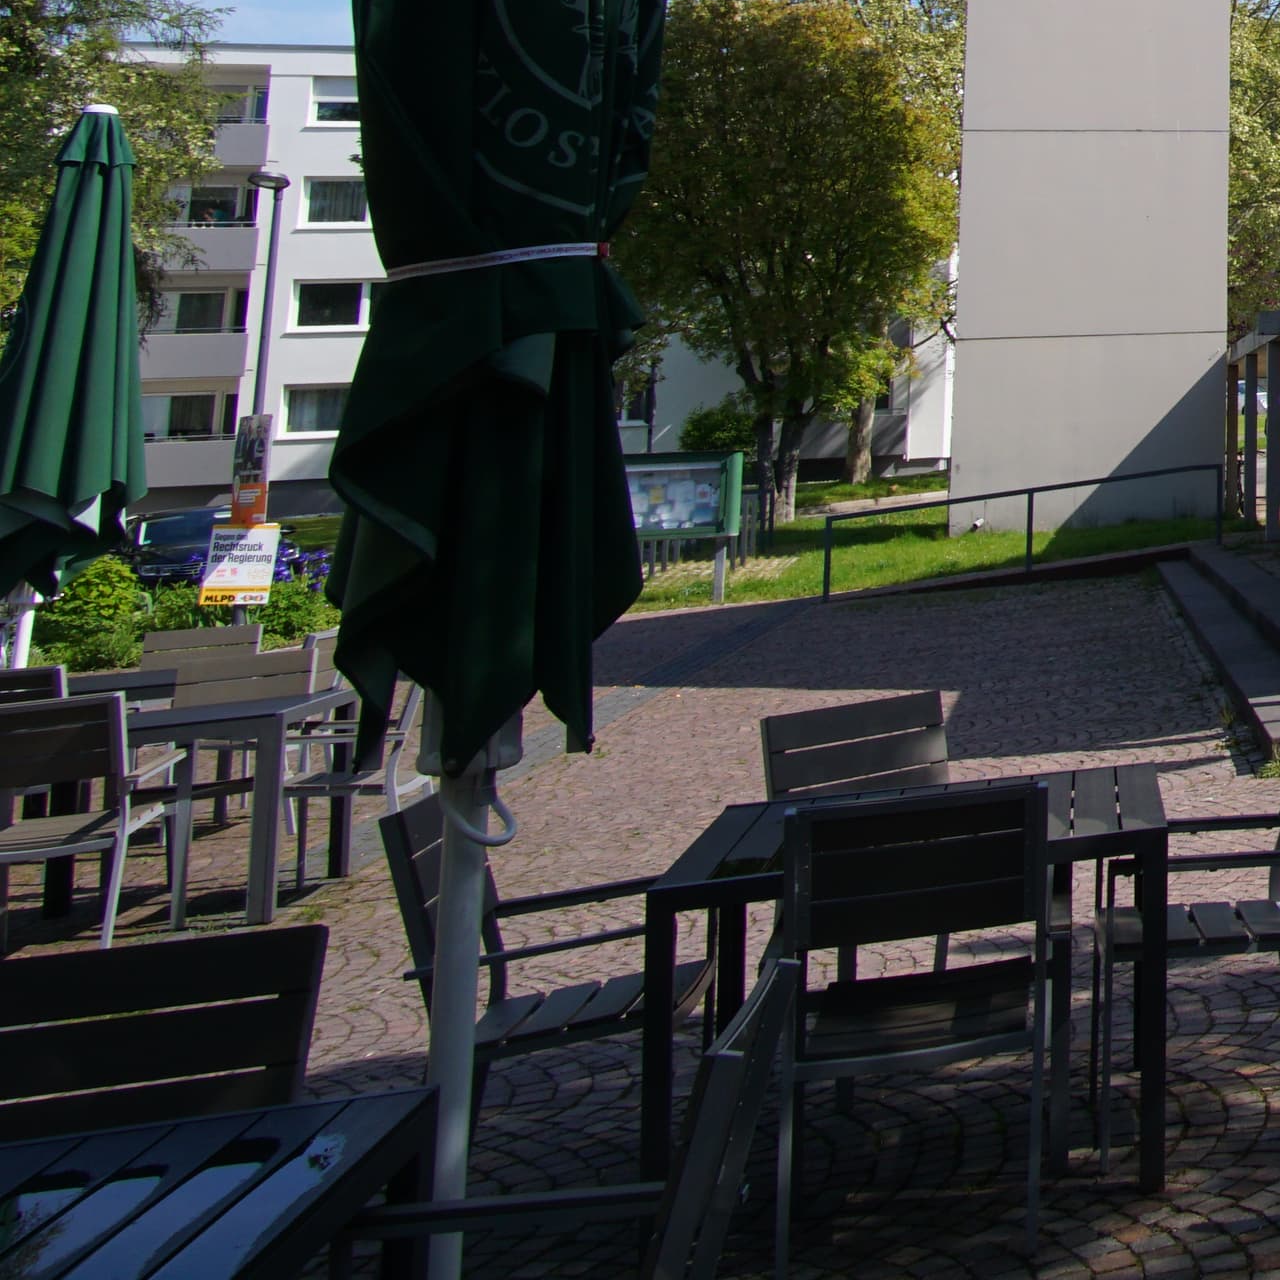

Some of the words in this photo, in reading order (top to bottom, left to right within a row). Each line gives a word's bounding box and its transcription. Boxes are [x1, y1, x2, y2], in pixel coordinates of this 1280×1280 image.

[212, 541, 264, 552] Rechtsruck
[210, 553, 227, 563] der
[227, 553, 273, 564] Regierung
[204, 594, 236, 603] MLPD
